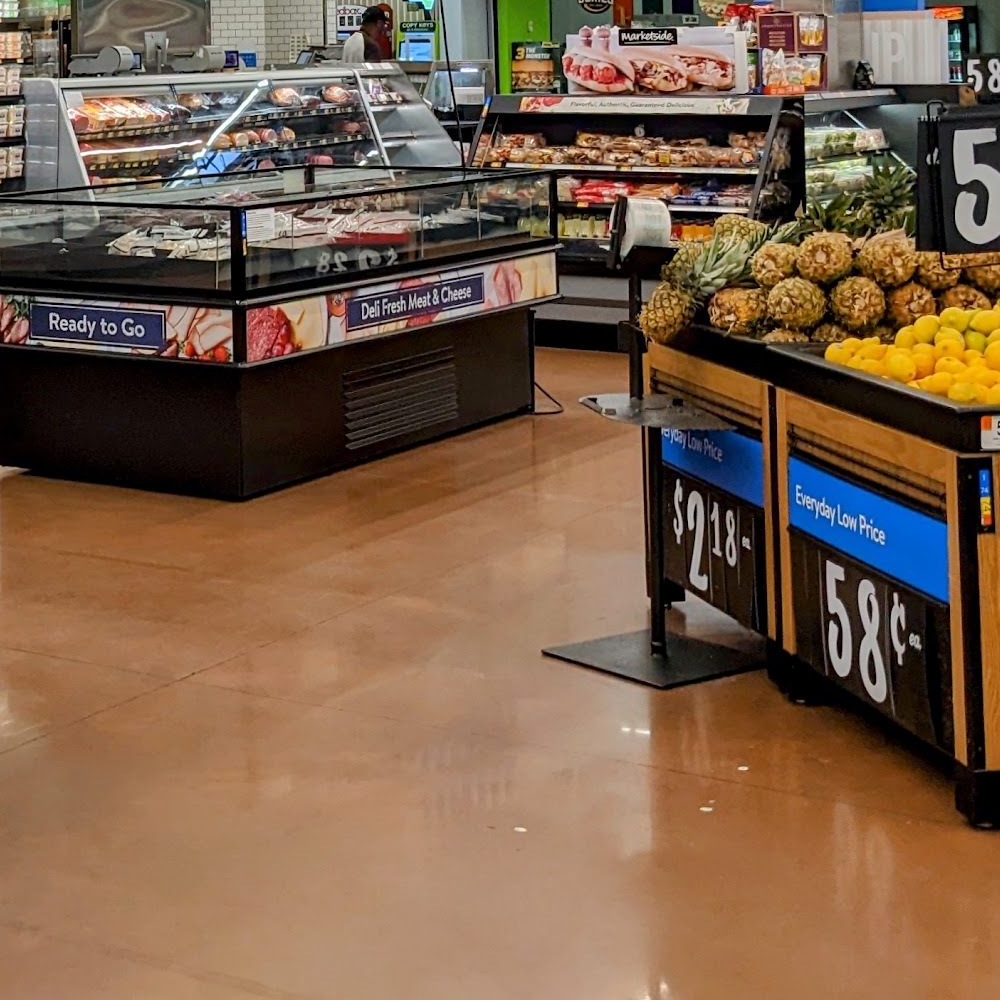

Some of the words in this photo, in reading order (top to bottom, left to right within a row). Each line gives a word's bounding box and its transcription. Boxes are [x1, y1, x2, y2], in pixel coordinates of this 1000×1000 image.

[401, 22, 418, 30] COPY
[515, 46, 525, 60] 3
[361, 299, 380, 320] Deli
[382, 297, 407, 316] Fresh
[408, 292, 431, 310] Meat
[432, 288, 440, 305] &
[441, 286, 472, 303] Cheese
[49, 312, 96, 339] Ready
[100, 318, 118, 335] to
[121, 318, 145, 338] Go
[661, 427, 687, 449] eryday
[687, 430, 703, 453] Low
[703, 437, 723, 463] Price
[795, 484, 837, 527] Everyday
[837, 504, 857, 532] Low
[859, 514, 886, 546] Price
